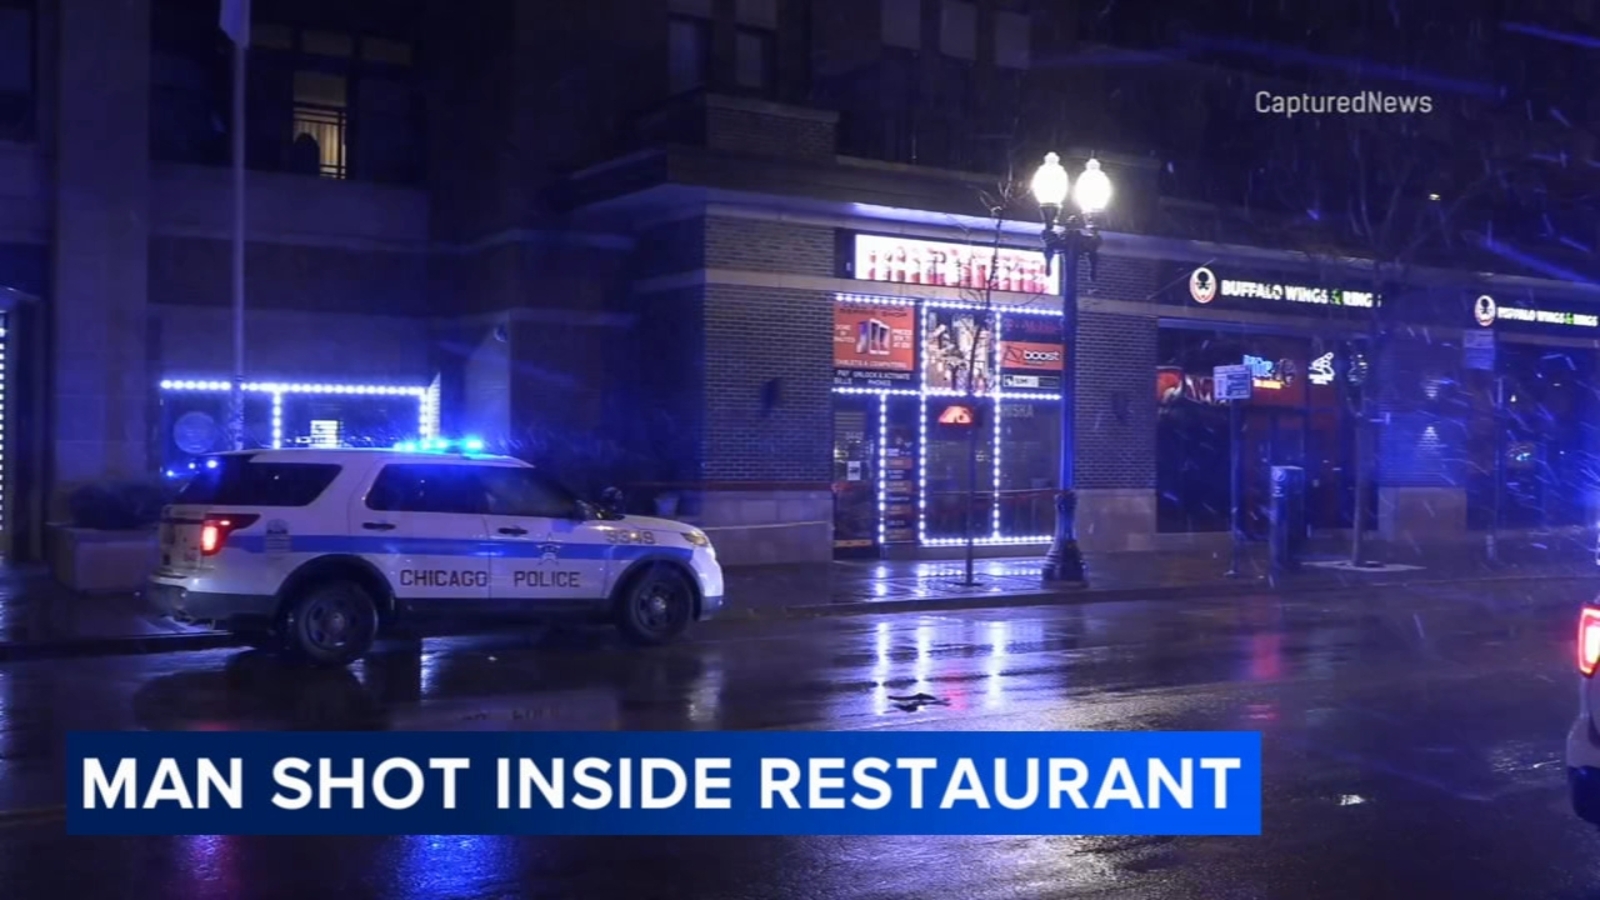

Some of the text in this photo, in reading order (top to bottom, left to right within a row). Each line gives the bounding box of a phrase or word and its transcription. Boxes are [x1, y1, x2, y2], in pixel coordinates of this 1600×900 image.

[1221, 280, 1283, 300] BUFFALO
[1285, 285, 1328, 304] WINGS
[1024, 350, 1060, 361] boost
[400, 569, 581, 588] CHICAGO POLICE
